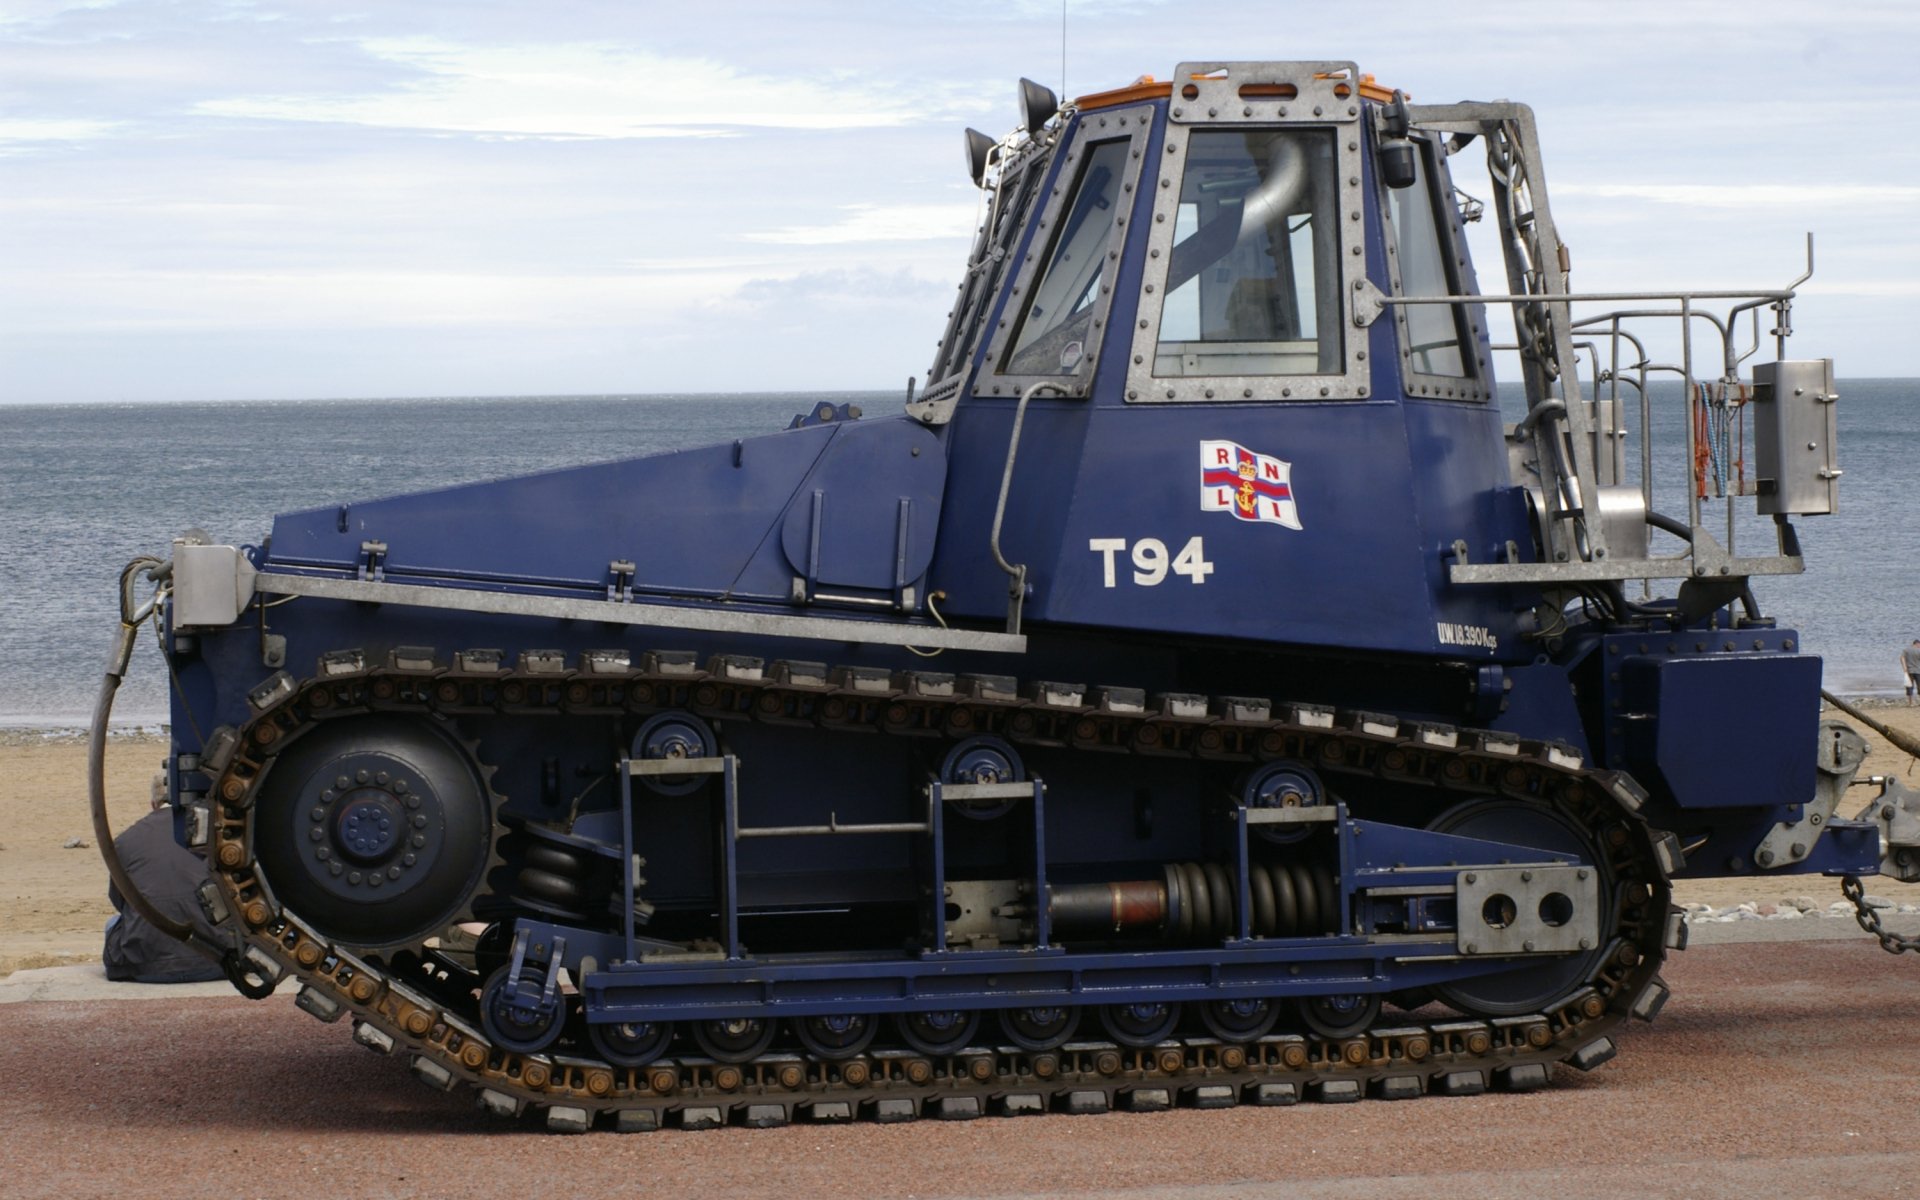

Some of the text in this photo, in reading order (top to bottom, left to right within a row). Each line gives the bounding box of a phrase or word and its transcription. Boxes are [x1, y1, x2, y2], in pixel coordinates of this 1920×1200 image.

[1216, 448, 1280, 480] R N
[1217, 489, 1281, 518] L I
[1089, 536, 1214, 588] T94
